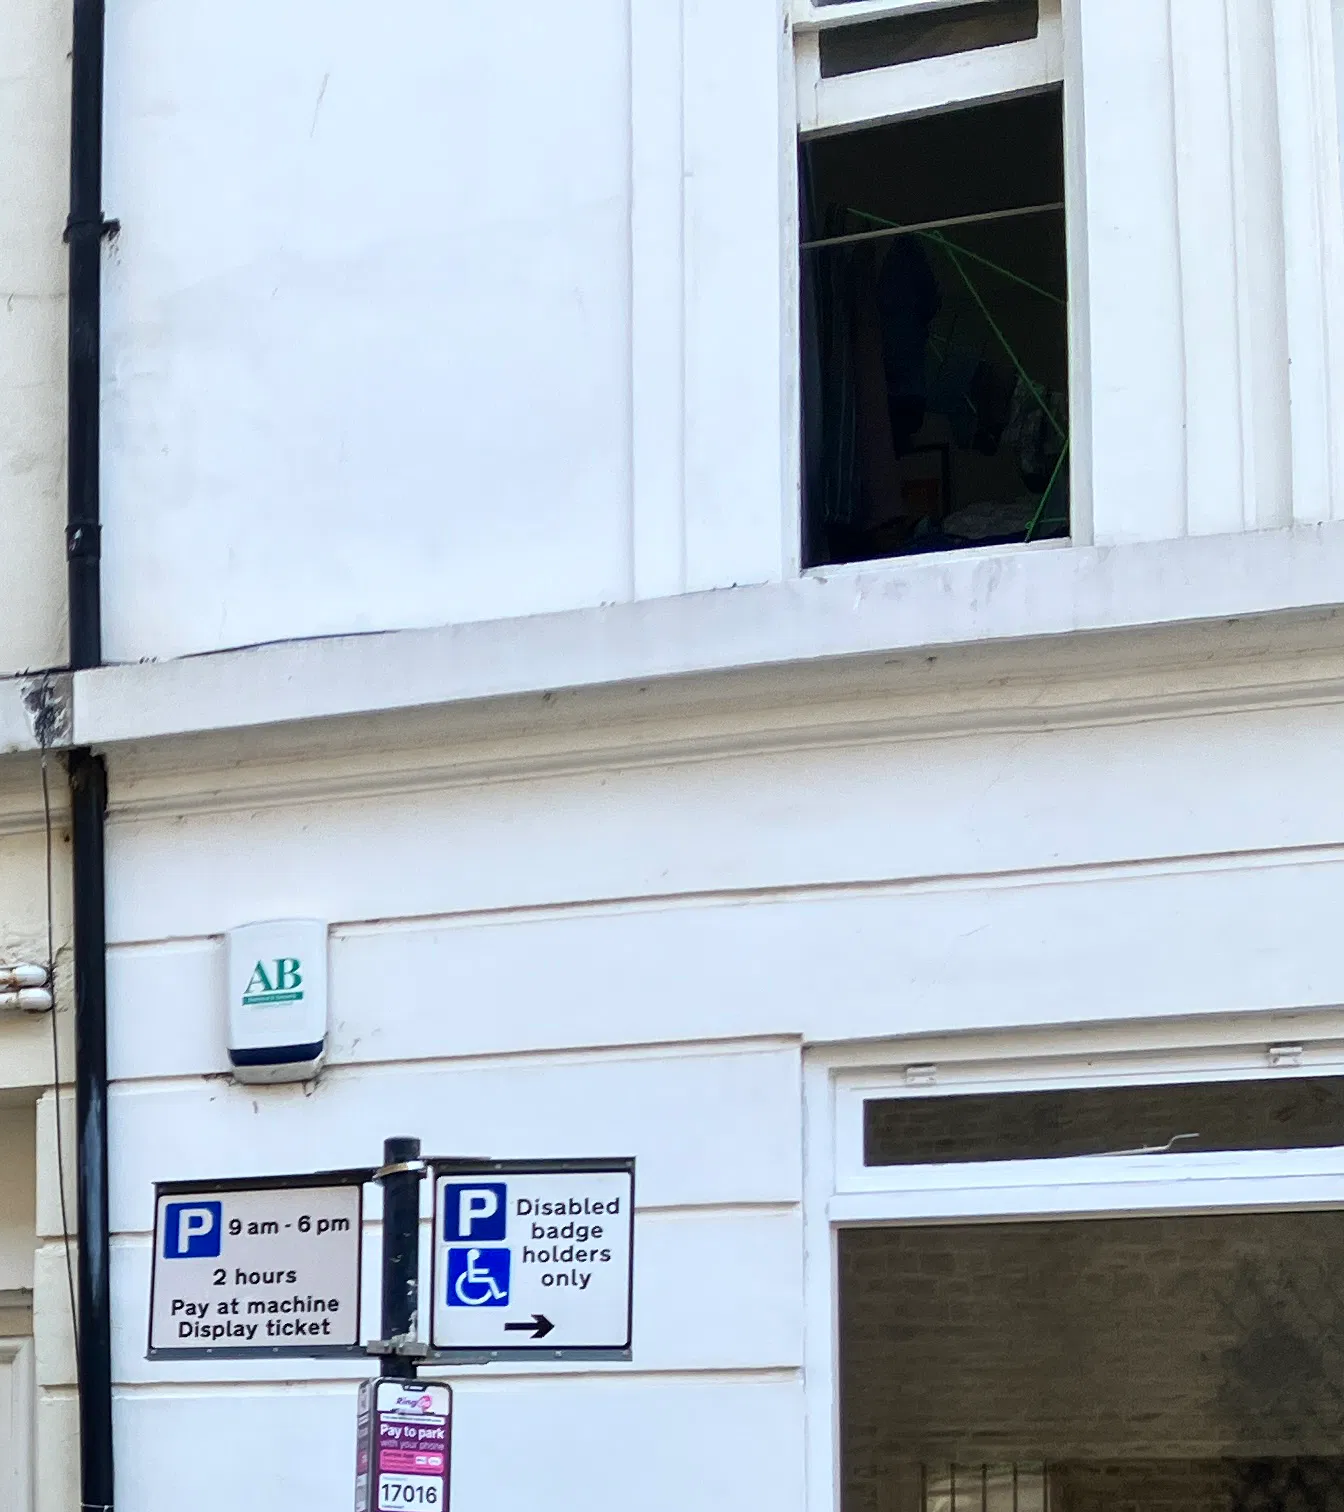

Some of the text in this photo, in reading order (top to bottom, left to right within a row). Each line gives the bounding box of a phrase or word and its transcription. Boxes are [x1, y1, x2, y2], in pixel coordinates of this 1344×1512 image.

[243, 957, 302, 994] AB
[459, 1189, 498, 1237] P
[516, 1197, 620, 1216] Disabled
[178, 1208, 213, 1253] P
[531, 1222, 603, 1242] badge
[522, 1245, 611, 1263] holders
[213, 1268, 297, 1285] 2 hours
[541, 1269, 592, 1290] only
[171, 1295, 339, 1318] Pay at machine
[178, 1318, 331, 1340] Display ticket
[380, 1423, 445, 1442] Pay to park
[400, 1441, 419, 1450] your
[419, 1442, 445, 1450] phone
[381, 1484, 437, 1504] 17016
